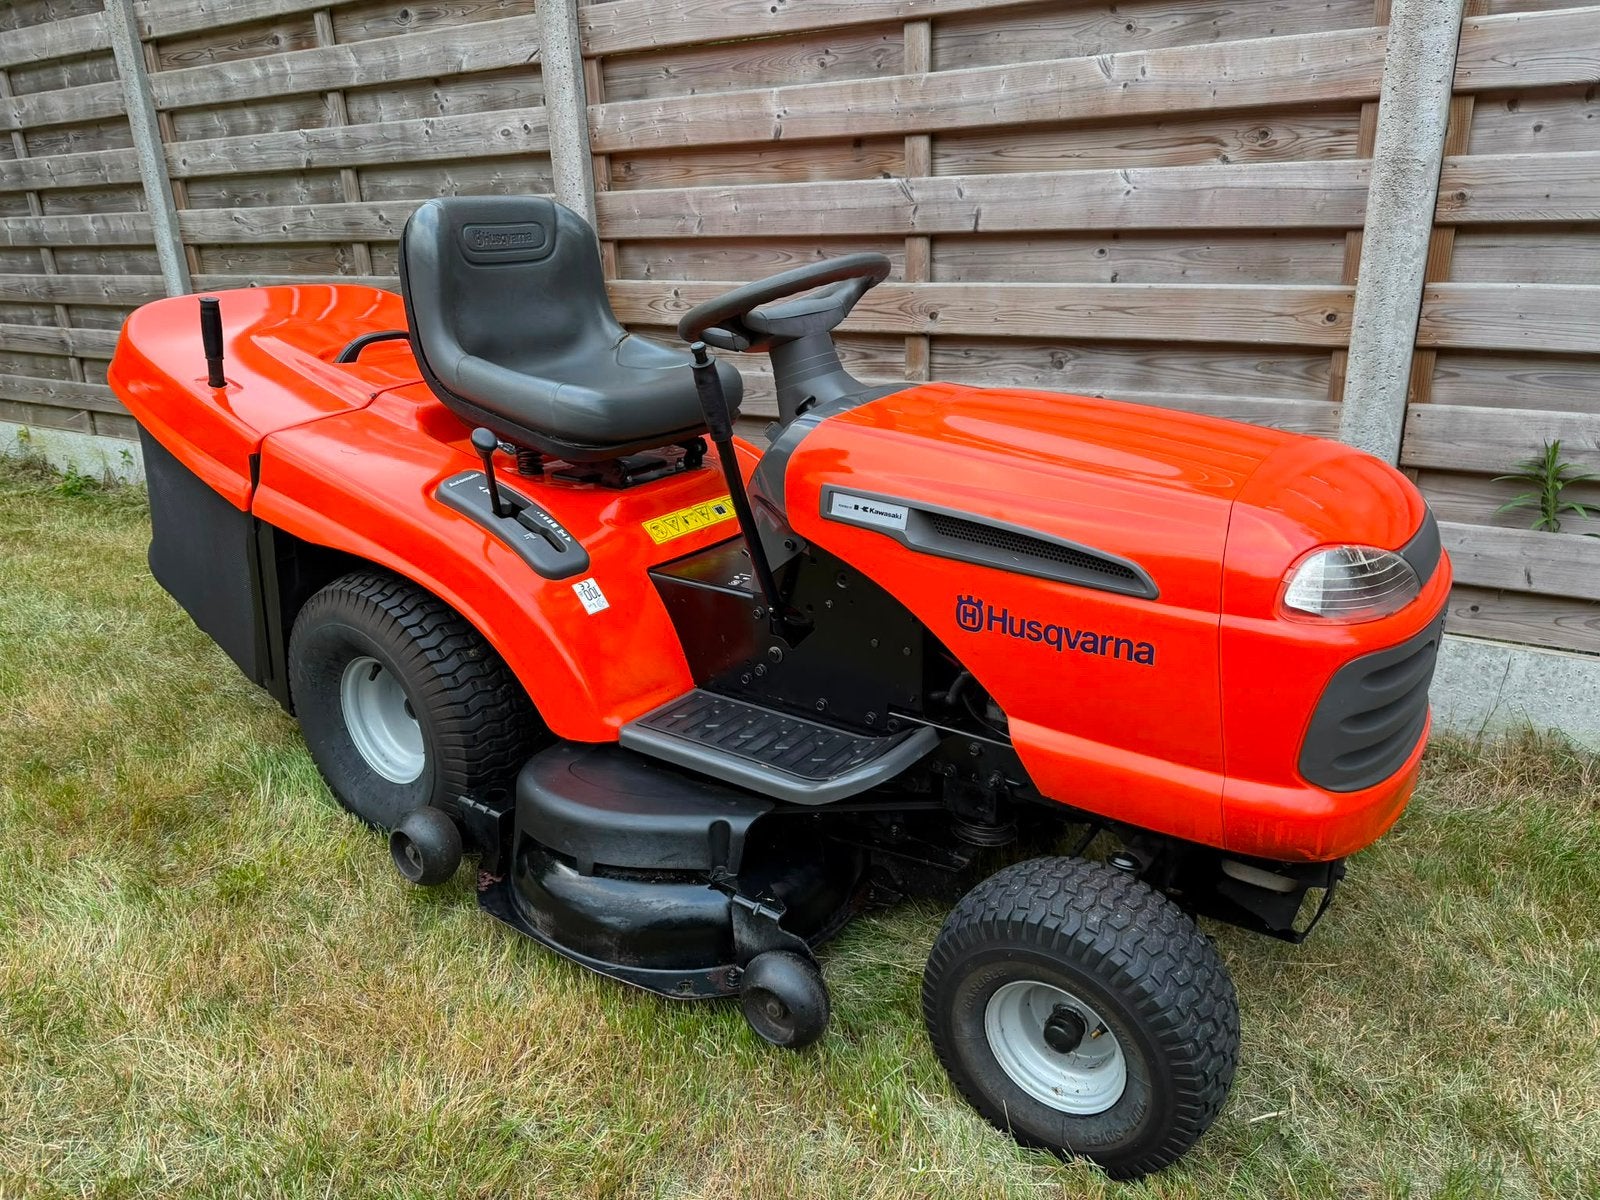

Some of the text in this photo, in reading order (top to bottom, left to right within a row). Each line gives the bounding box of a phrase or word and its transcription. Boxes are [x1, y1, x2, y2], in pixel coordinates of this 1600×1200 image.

[484, 230, 534, 247] Husqvarna
[869, 508, 902, 520] Kawasaki
[583, 586, 601, 601] 100
[987, 605, 1155, 665] Husqvarna
